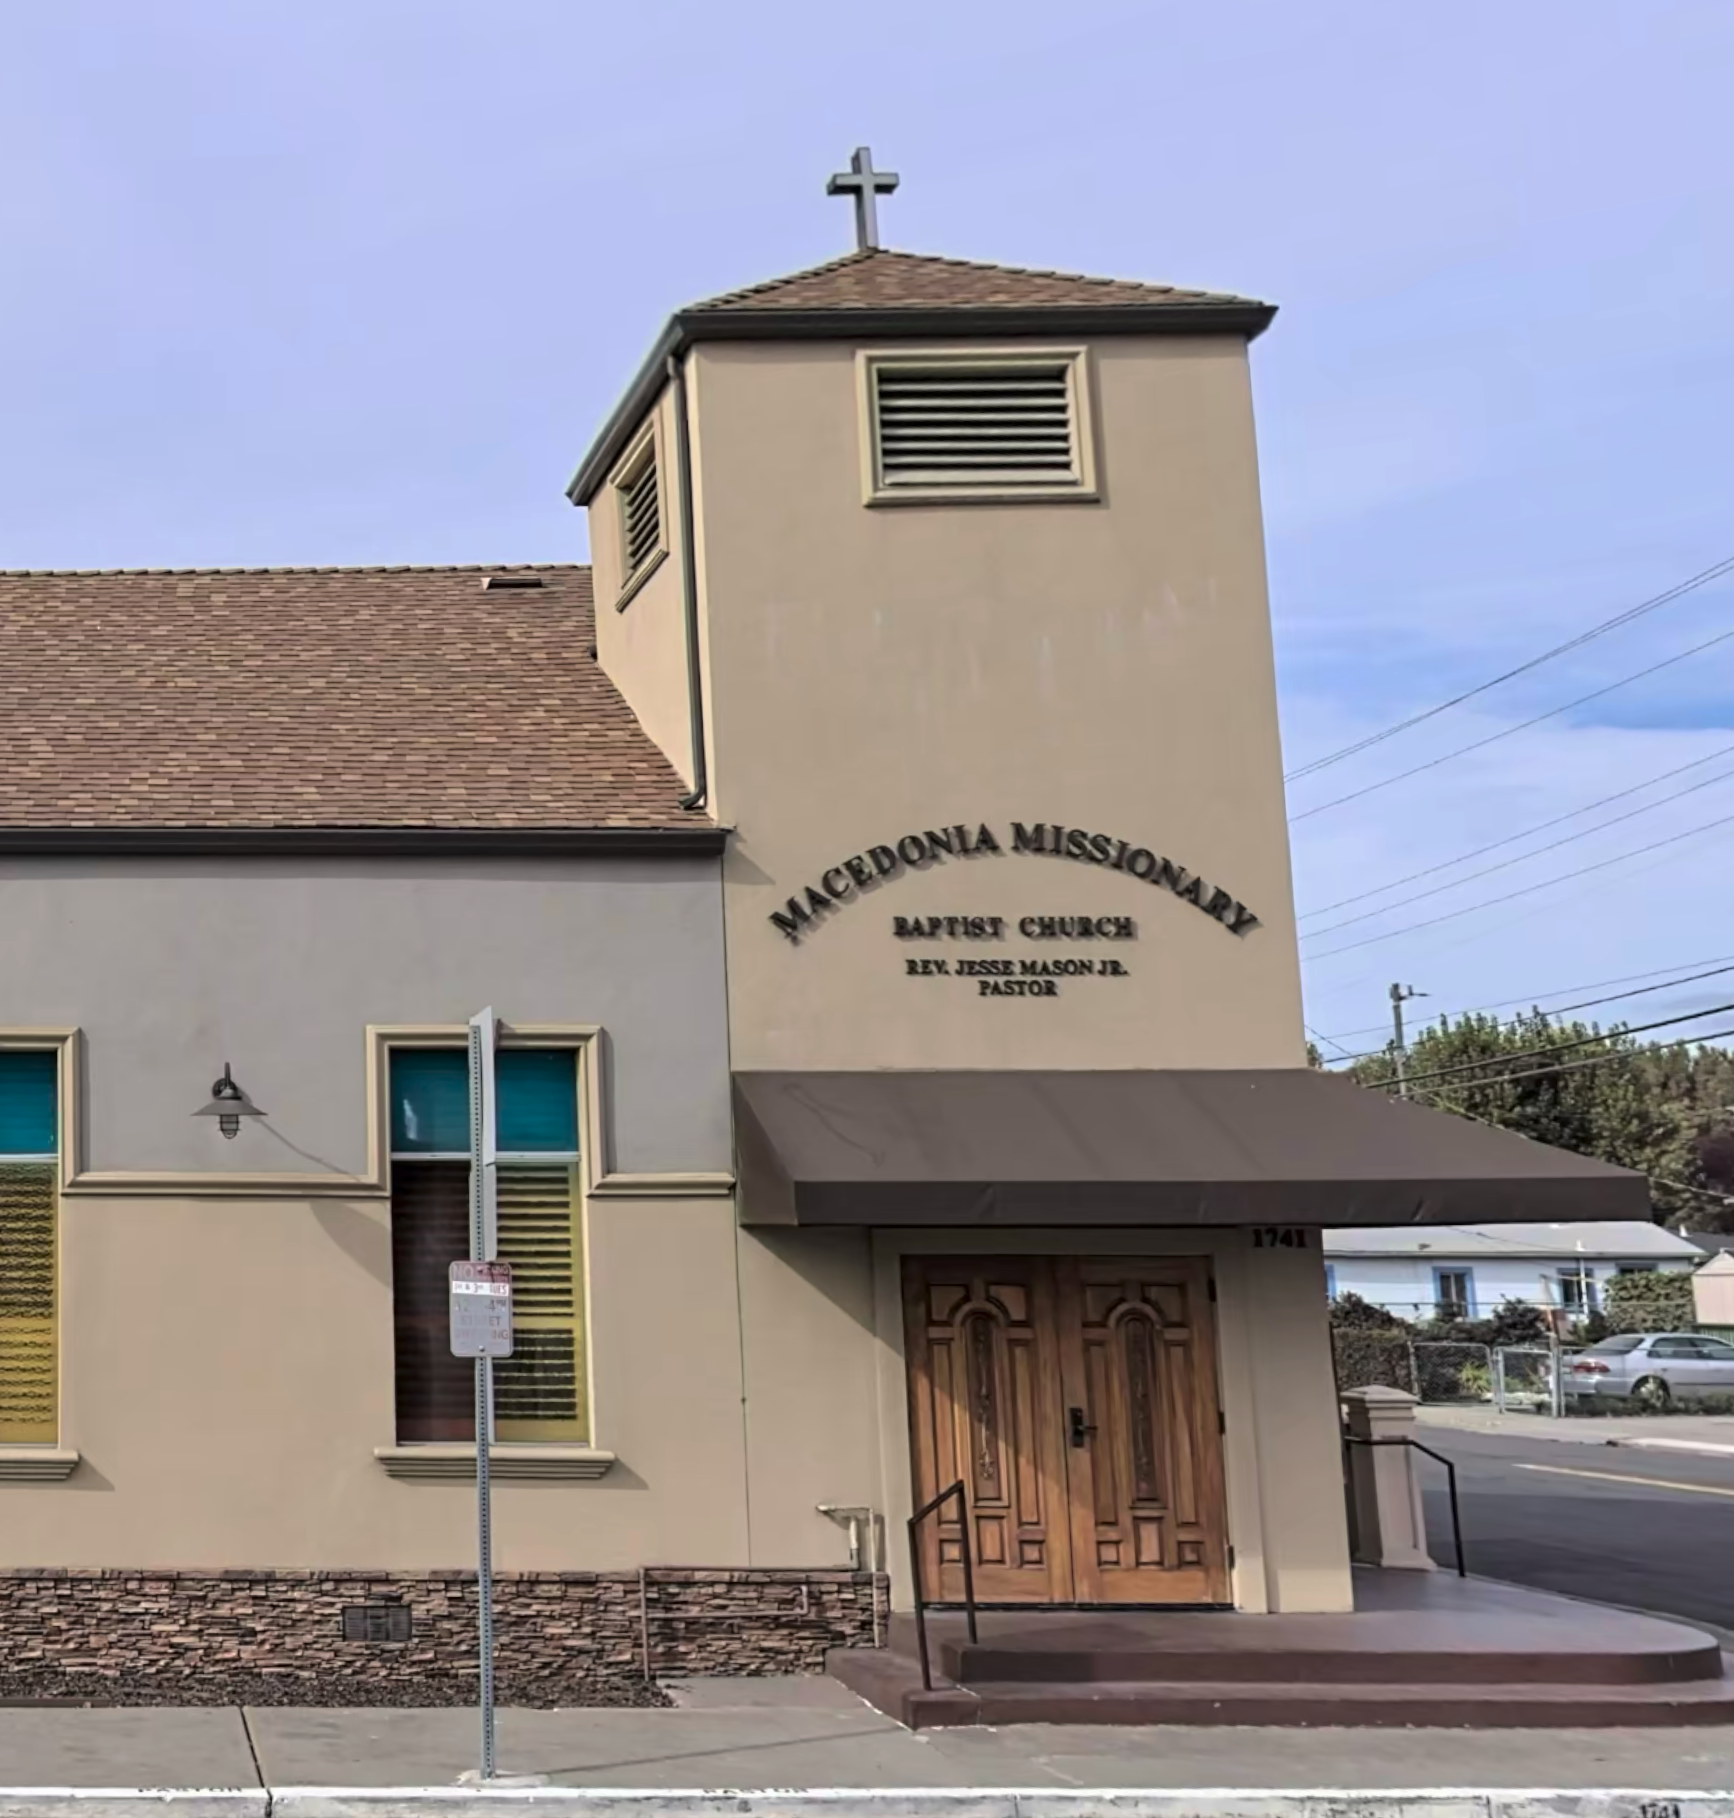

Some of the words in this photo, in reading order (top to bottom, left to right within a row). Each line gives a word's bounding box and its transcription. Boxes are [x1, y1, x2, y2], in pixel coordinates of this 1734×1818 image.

[768, 822, 1000, 938] MACEDONIA
[1010, 821, 1258, 936] MISSIONARY
[893, 915, 1003, 937] BAPTIST
[1018, 915, 1133, 938] CHURCH
[905, 958, 951, 977] REV.
[955, 958, 1015, 977] JESSE
[1019, 959, 1093, 977] MASON
[1097, 959, 1130, 977] JR.
[978, 979, 1058, 997] PASTOR
[1253, 1227, 1307, 1248] 1741
